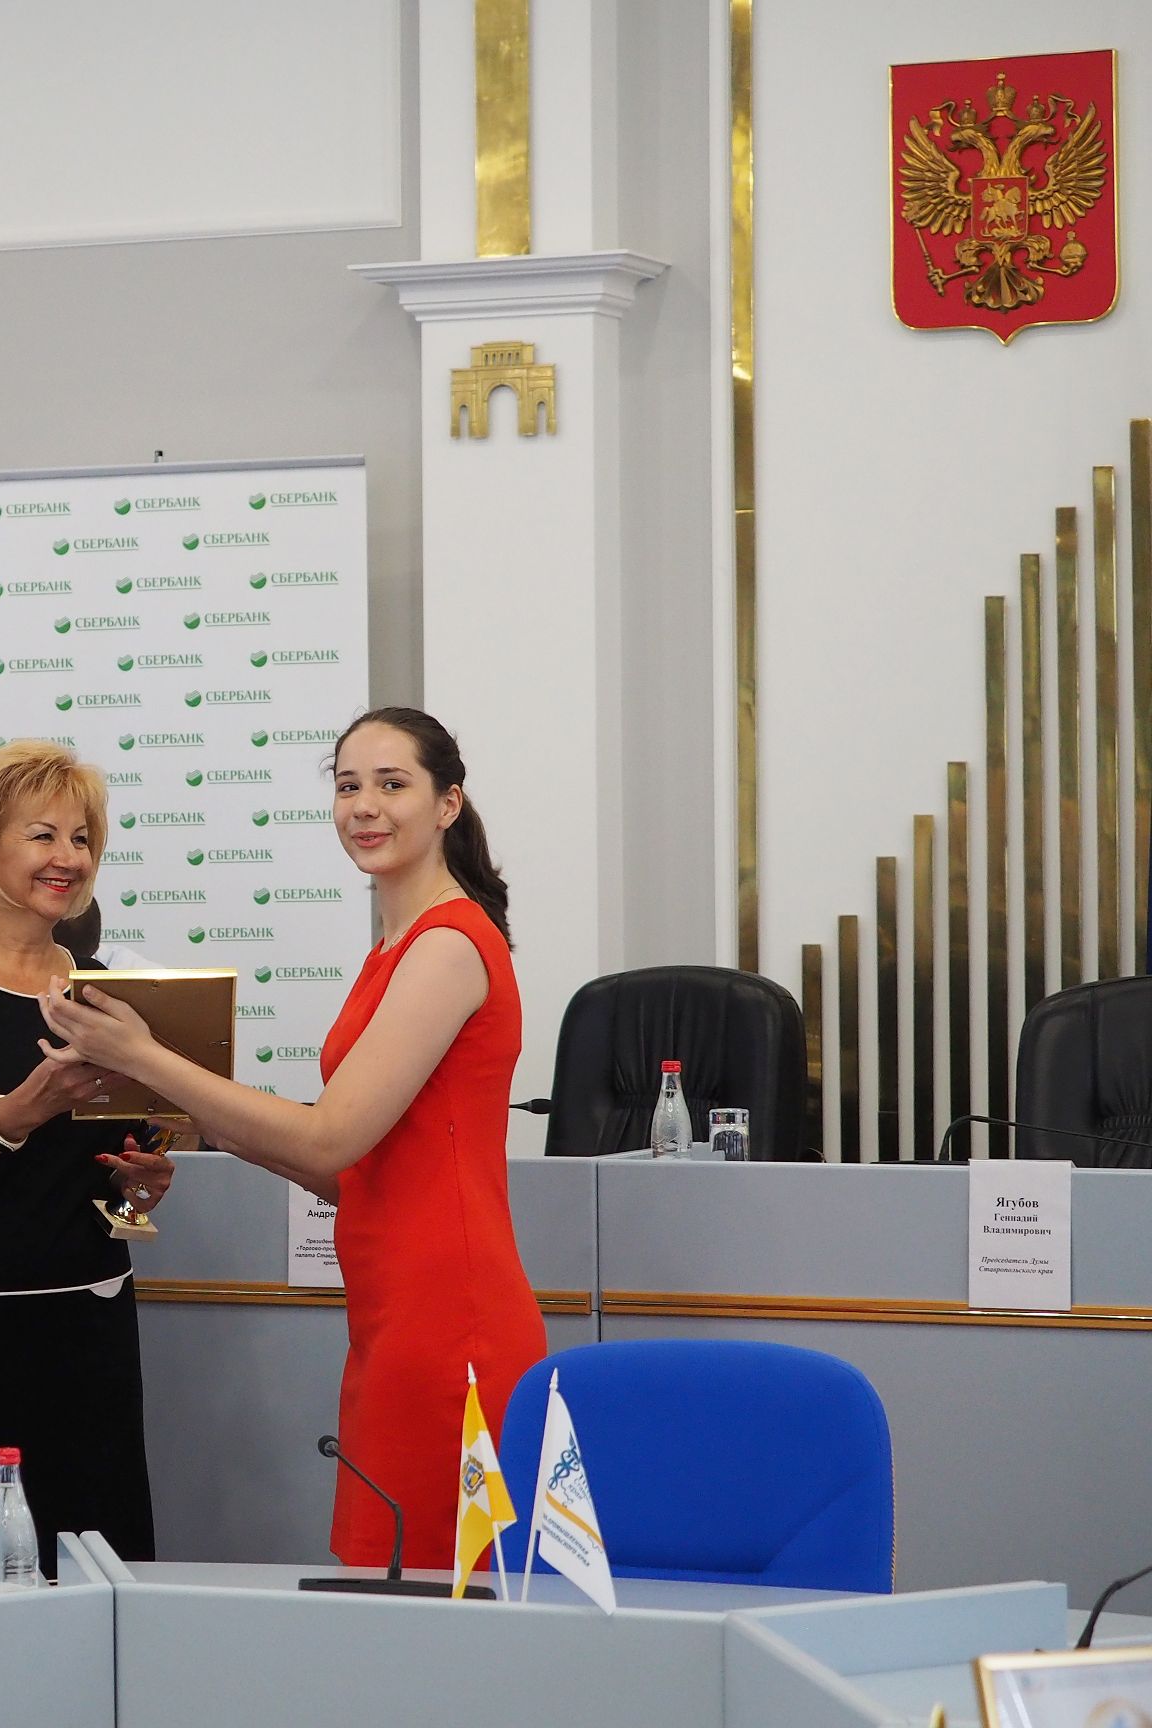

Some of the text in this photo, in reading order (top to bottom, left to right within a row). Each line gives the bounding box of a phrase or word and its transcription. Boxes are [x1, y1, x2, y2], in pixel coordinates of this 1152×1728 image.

[135, 497, 200, 510] СБЕРБАНК
[270, 492, 337, 505] СБЕРБАНК
[6, 502, 70, 515] СБЕРБАНК
[73, 537, 139, 550] СБЕРБАНК
[203, 533, 269, 545] СБЕРБАНК
[136, 576, 202, 589] СБЕРБАНК
[271, 572, 338, 584] СБЕРБАНК
[7, 581, 72, 594] СБЕРБАНК
[75, 616, 140, 628] СБЕРБАНК
[204, 612, 270, 624] СБЕРБАНК
[138, 653, 203, 666] СБЕРБАНК
[272, 650, 339, 662] СБЕРБАНК
[8, 658, 73, 670] СБЕРБАНК
[77, 693, 141, 706] СБЕРБАНК
[206, 689, 271, 702] СБЕРБАНК
[138, 733, 204, 746] СБЕРБАНК
[272, 729, 340, 742] СБЕРБАНК
[207, 770, 271, 782] СБЕРБАНК
[139, 812, 205, 824] СБЕРБАНК
[273, 810, 334, 822] СБЕРБАН
[208, 849, 273, 861] СБЕРБАНК
[141, 890, 206, 902] СБЕРБАНК
[274, 888, 342, 900] СБЕРБАНК
[209, 927, 274, 939] СБЕРБАНК
[275, 967, 342, 979] СБЕРБАНК
[235, 1005, 276, 1016] РБАНК
[996, 1197, 1039, 1210] Ягубов
[307, 1209, 335, 1219] Андре
[994, 1213, 1038, 1223] Геннадий
[983, 1225, 1052, 1237] Владимирович
